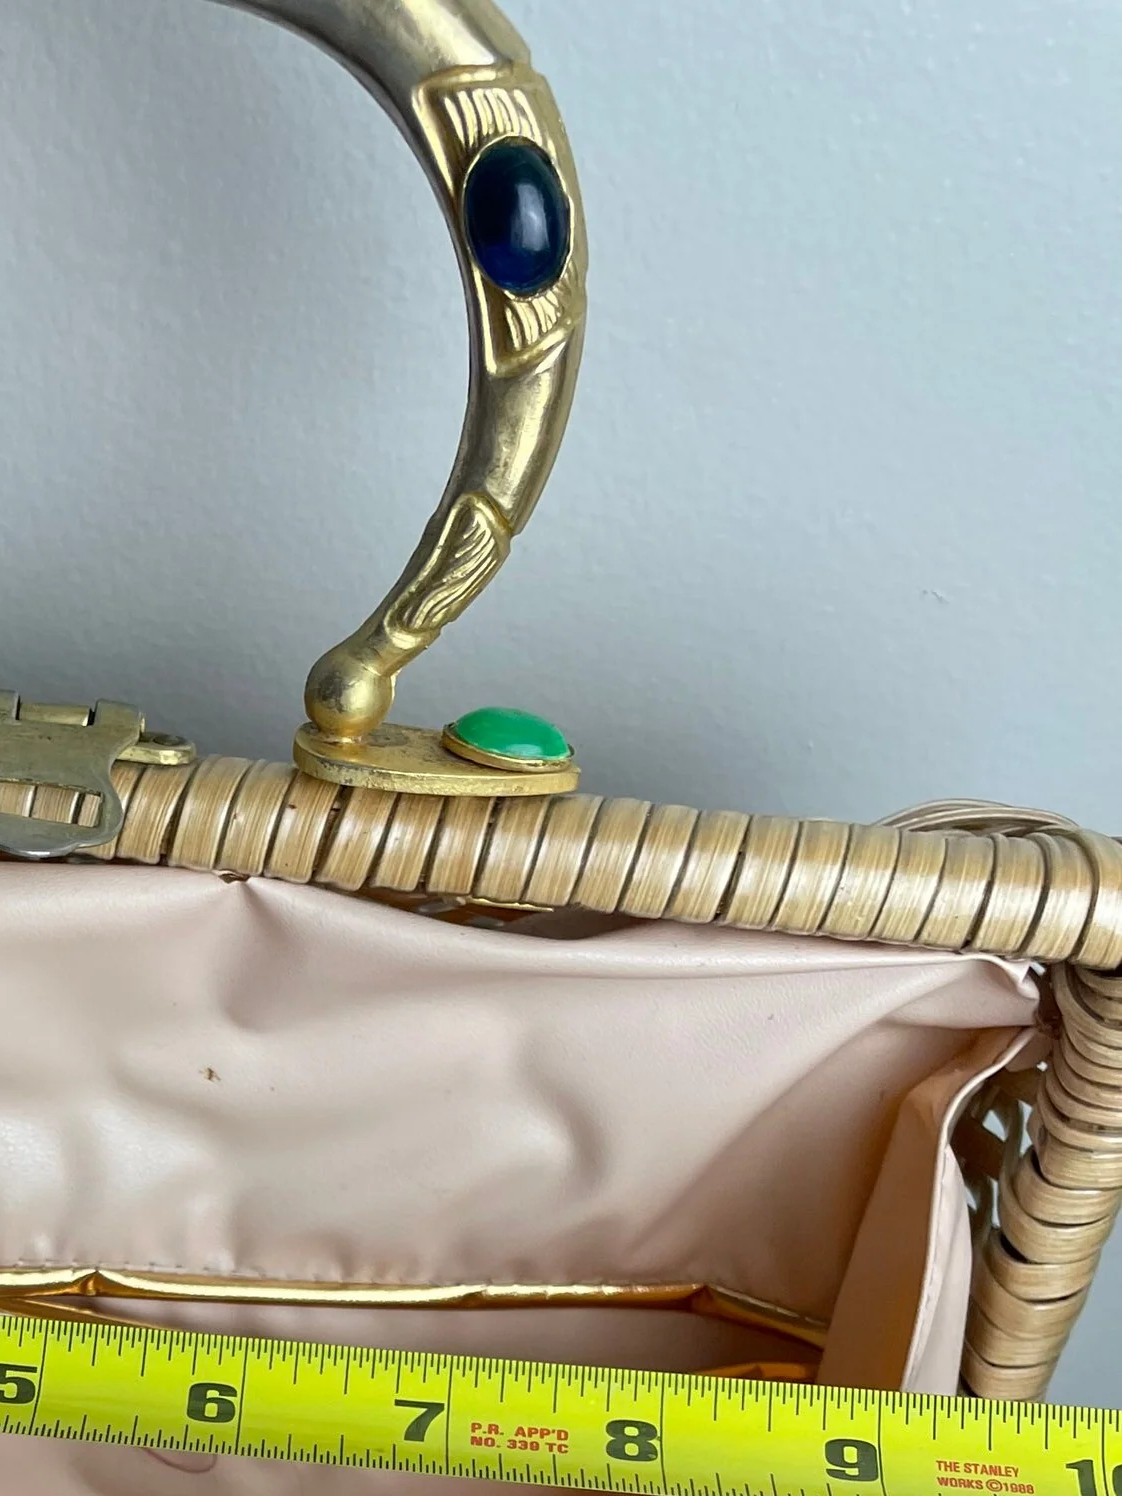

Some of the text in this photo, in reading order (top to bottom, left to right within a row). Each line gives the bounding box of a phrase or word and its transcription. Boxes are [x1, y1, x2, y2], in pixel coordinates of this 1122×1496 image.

[186, 1382, 238, 1423] 6
[394, 1398, 445, 1442] 7
[470, 1422, 569, 1441] P.R. APP'D
[470, 1435, 502, 1448] NO.
[544, 1442, 569, 1454] TC
[605, 1418, 658, 1462] 8
[825, 1438, 879, 1482] 9
[935, 1460, 1019, 1478] THE STANLEY
[937, 1476, 984, 1490] WORKS
